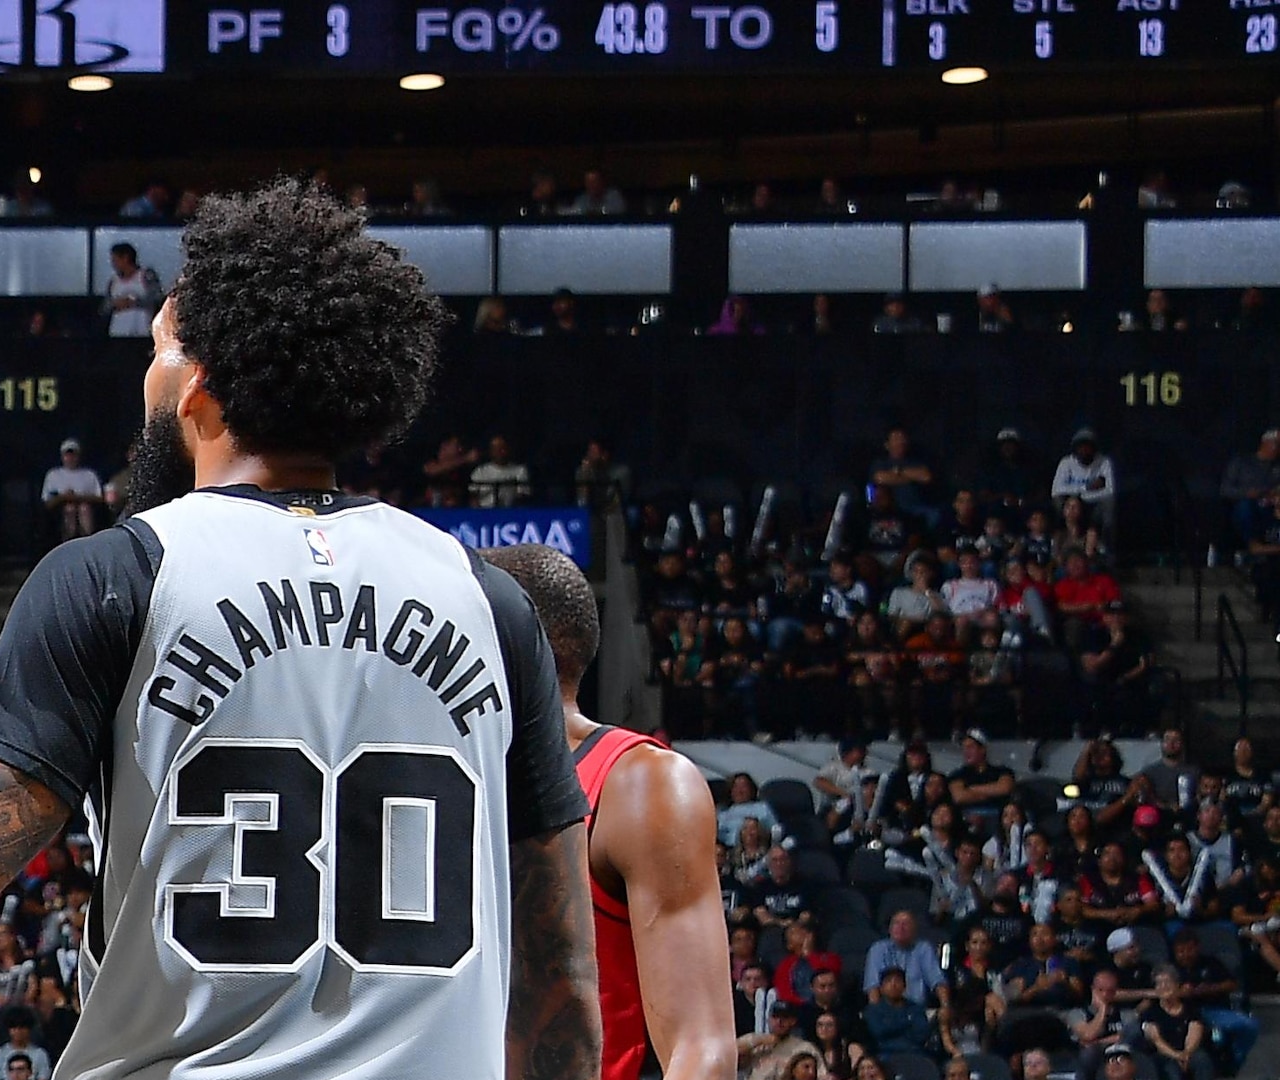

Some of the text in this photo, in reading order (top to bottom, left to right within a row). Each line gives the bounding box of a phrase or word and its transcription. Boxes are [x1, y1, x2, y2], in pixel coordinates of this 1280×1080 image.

[207, 0, 839, 57] PF 3 FG% 43.8 TO 5
[929, 13, 1279, 60] 3 5 13 23
[1120, 372, 1181, 406] 116
[146, 578, 503, 737] CHAMPAGNIE
[162, 737, 481, 976] 30
